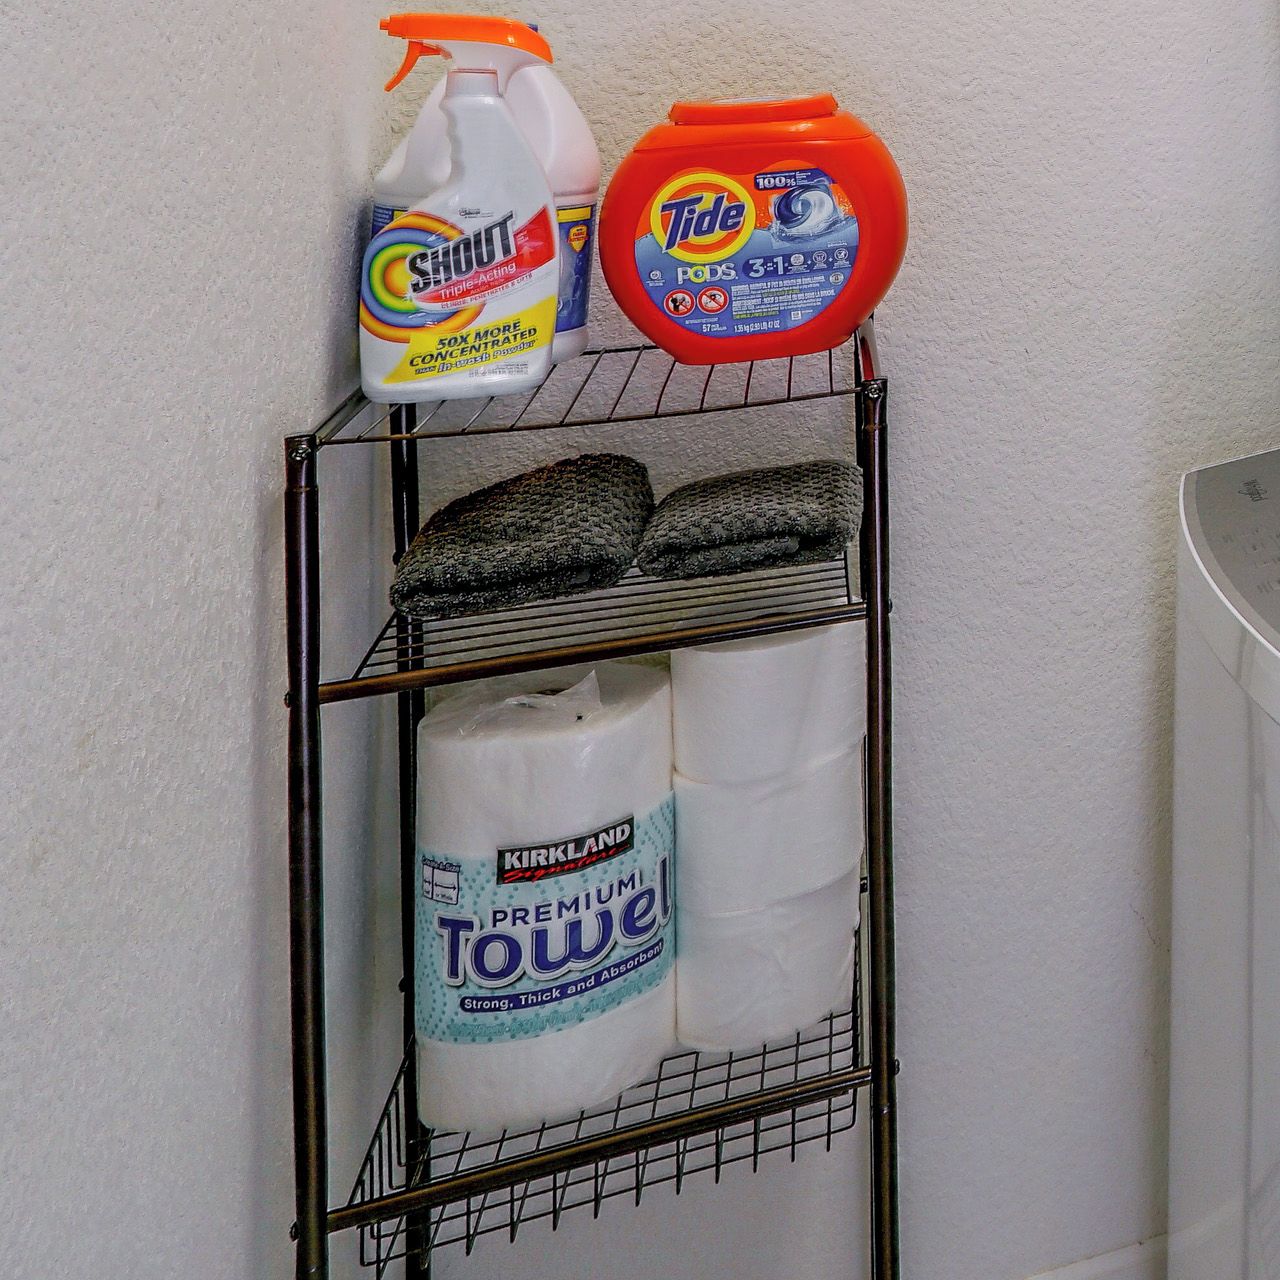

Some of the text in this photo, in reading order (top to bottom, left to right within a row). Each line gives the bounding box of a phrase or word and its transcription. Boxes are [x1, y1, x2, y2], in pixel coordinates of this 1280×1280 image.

[756, 177, 795, 189] 100%
[660, 192, 745, 253] Tide
[408, 211, 514, 293] SHOUT
[440, 262, 517, 300] Triple-Acting
[678, 263, 735, 285] PODS
[409, 328, 537, 367] CONCENTRATED
[436, 321, 520, 351] 50X MORE
[437, 353, 490, 372] In-Wash
[493, 340, 535, 358] Powder
[503, 844, 630, 883] Signature
[504, 823, 632, 869] KIRKLAND
[437, 856, 670, 981] Towel
[492, 872, 637, 928] PREMIUM
[519, 989, 561, 1005] Thick
[567, 977, 595, 994] and
[601, 942, 664, 980] Absorbent
